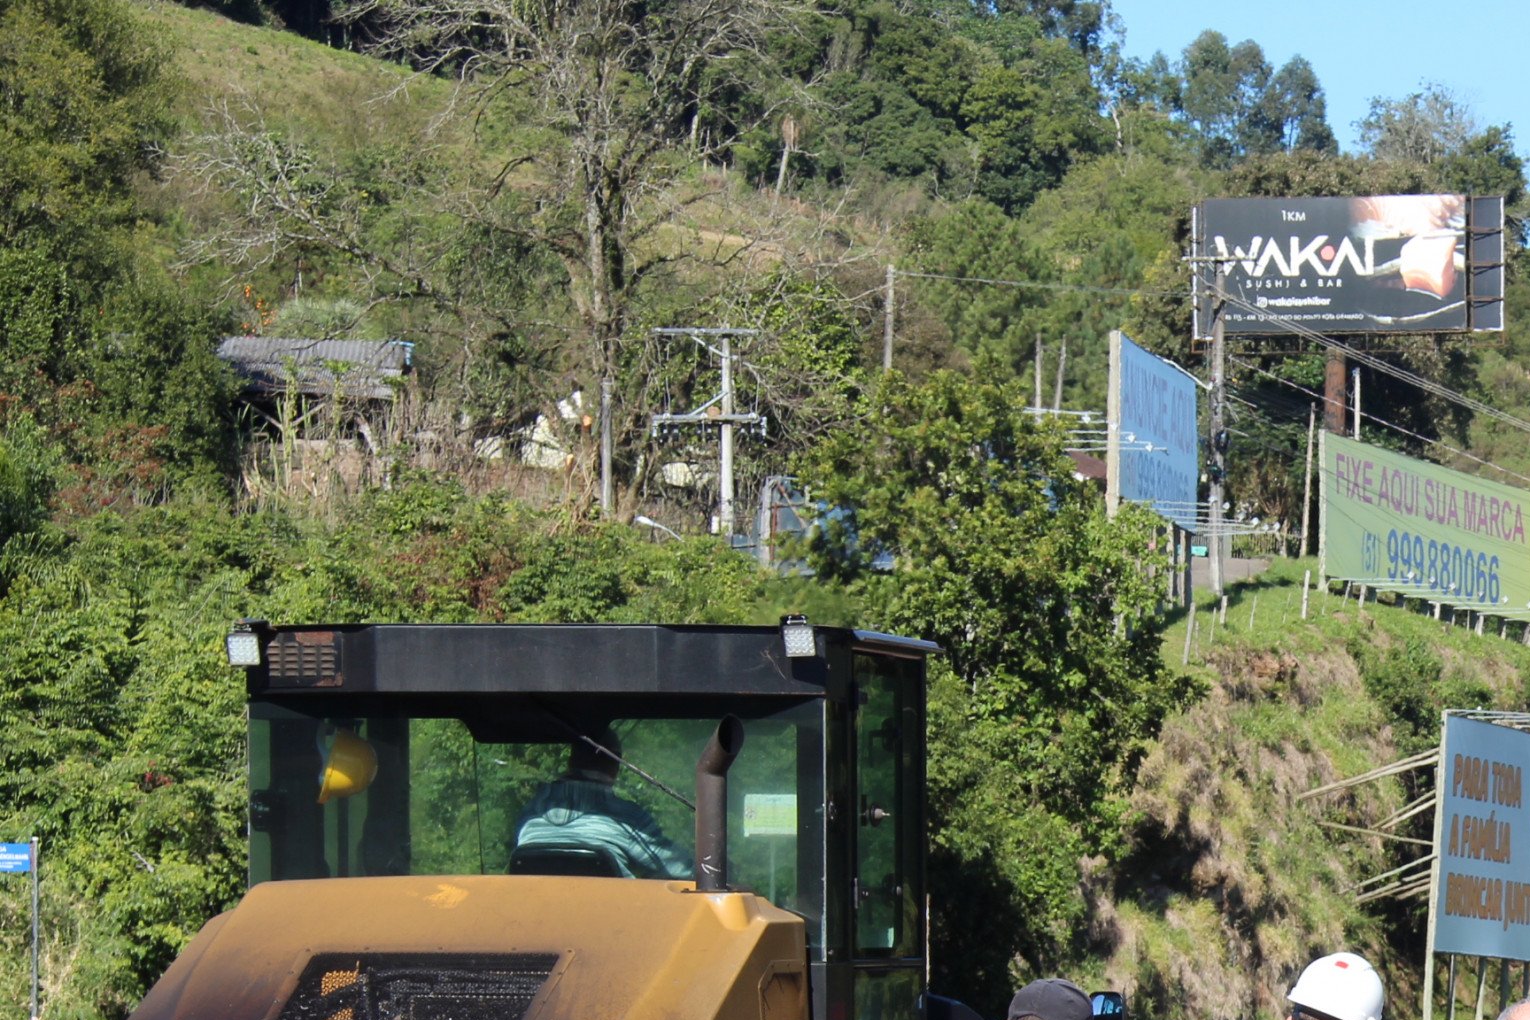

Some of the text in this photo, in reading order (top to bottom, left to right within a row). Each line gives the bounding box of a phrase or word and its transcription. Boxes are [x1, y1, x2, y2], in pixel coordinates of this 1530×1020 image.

[1281, 209, 1306, 222] 1KM
[1213, 234, 1375, 277] WAKAI
[1246, 278, 1342, 289] SUSHI & BAR
[1335, 453, 1525, 544] FIXE AQUI SUA MARCA
[1452, 753, 1522, 809] PARA TODA
[1448, 809, 1511, 864] A FAMÍLIA
[1445, 871, 1503, 922] BRINCAR
